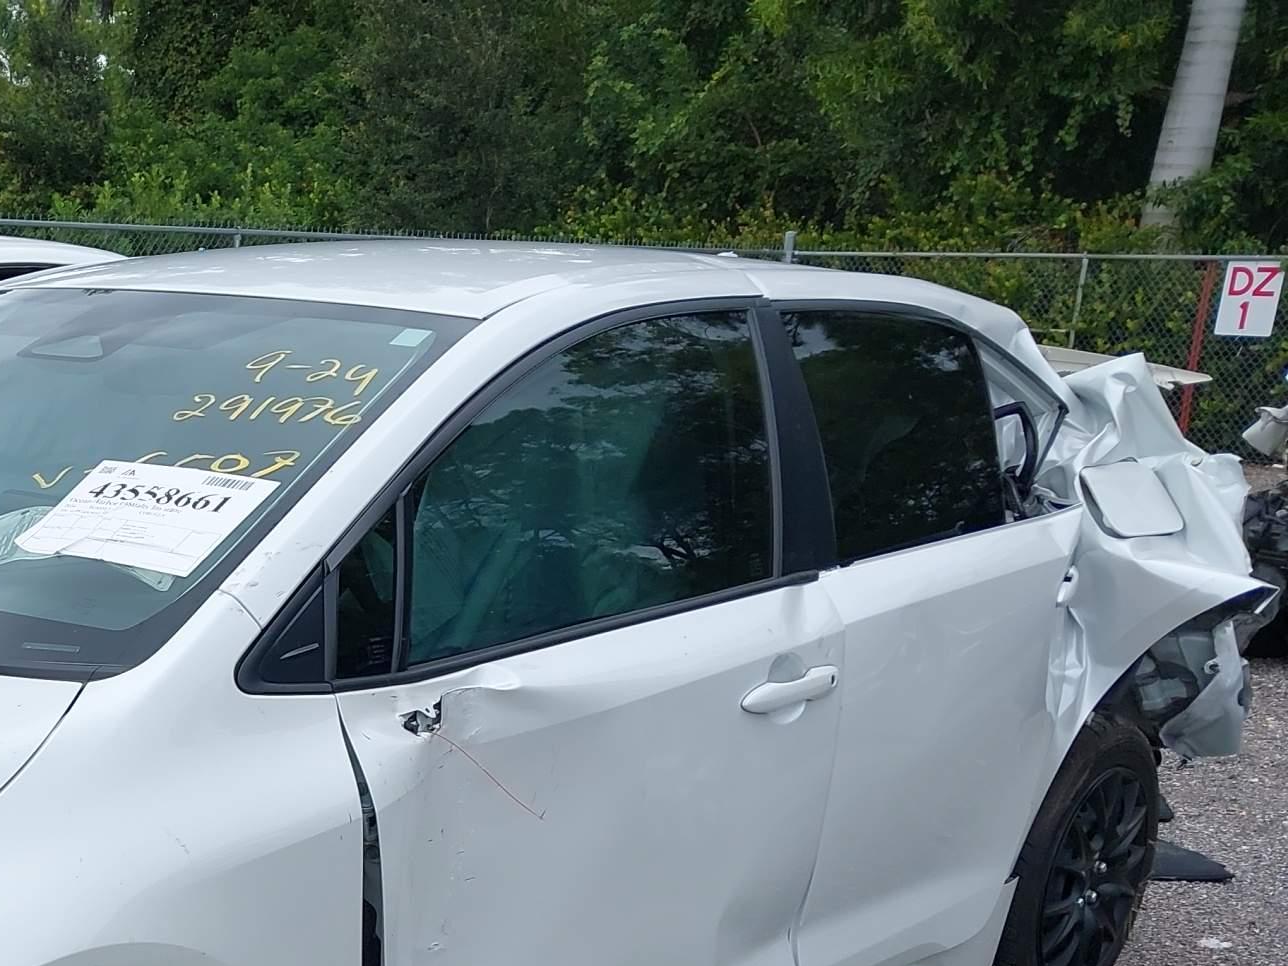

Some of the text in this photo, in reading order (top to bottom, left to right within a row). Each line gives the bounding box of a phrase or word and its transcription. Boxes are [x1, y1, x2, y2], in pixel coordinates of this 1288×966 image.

[1228, 266, 1282, 297] DZ
[1238, 301, 1250, 330] 1
[88, 481, 232, 513] 43558661
